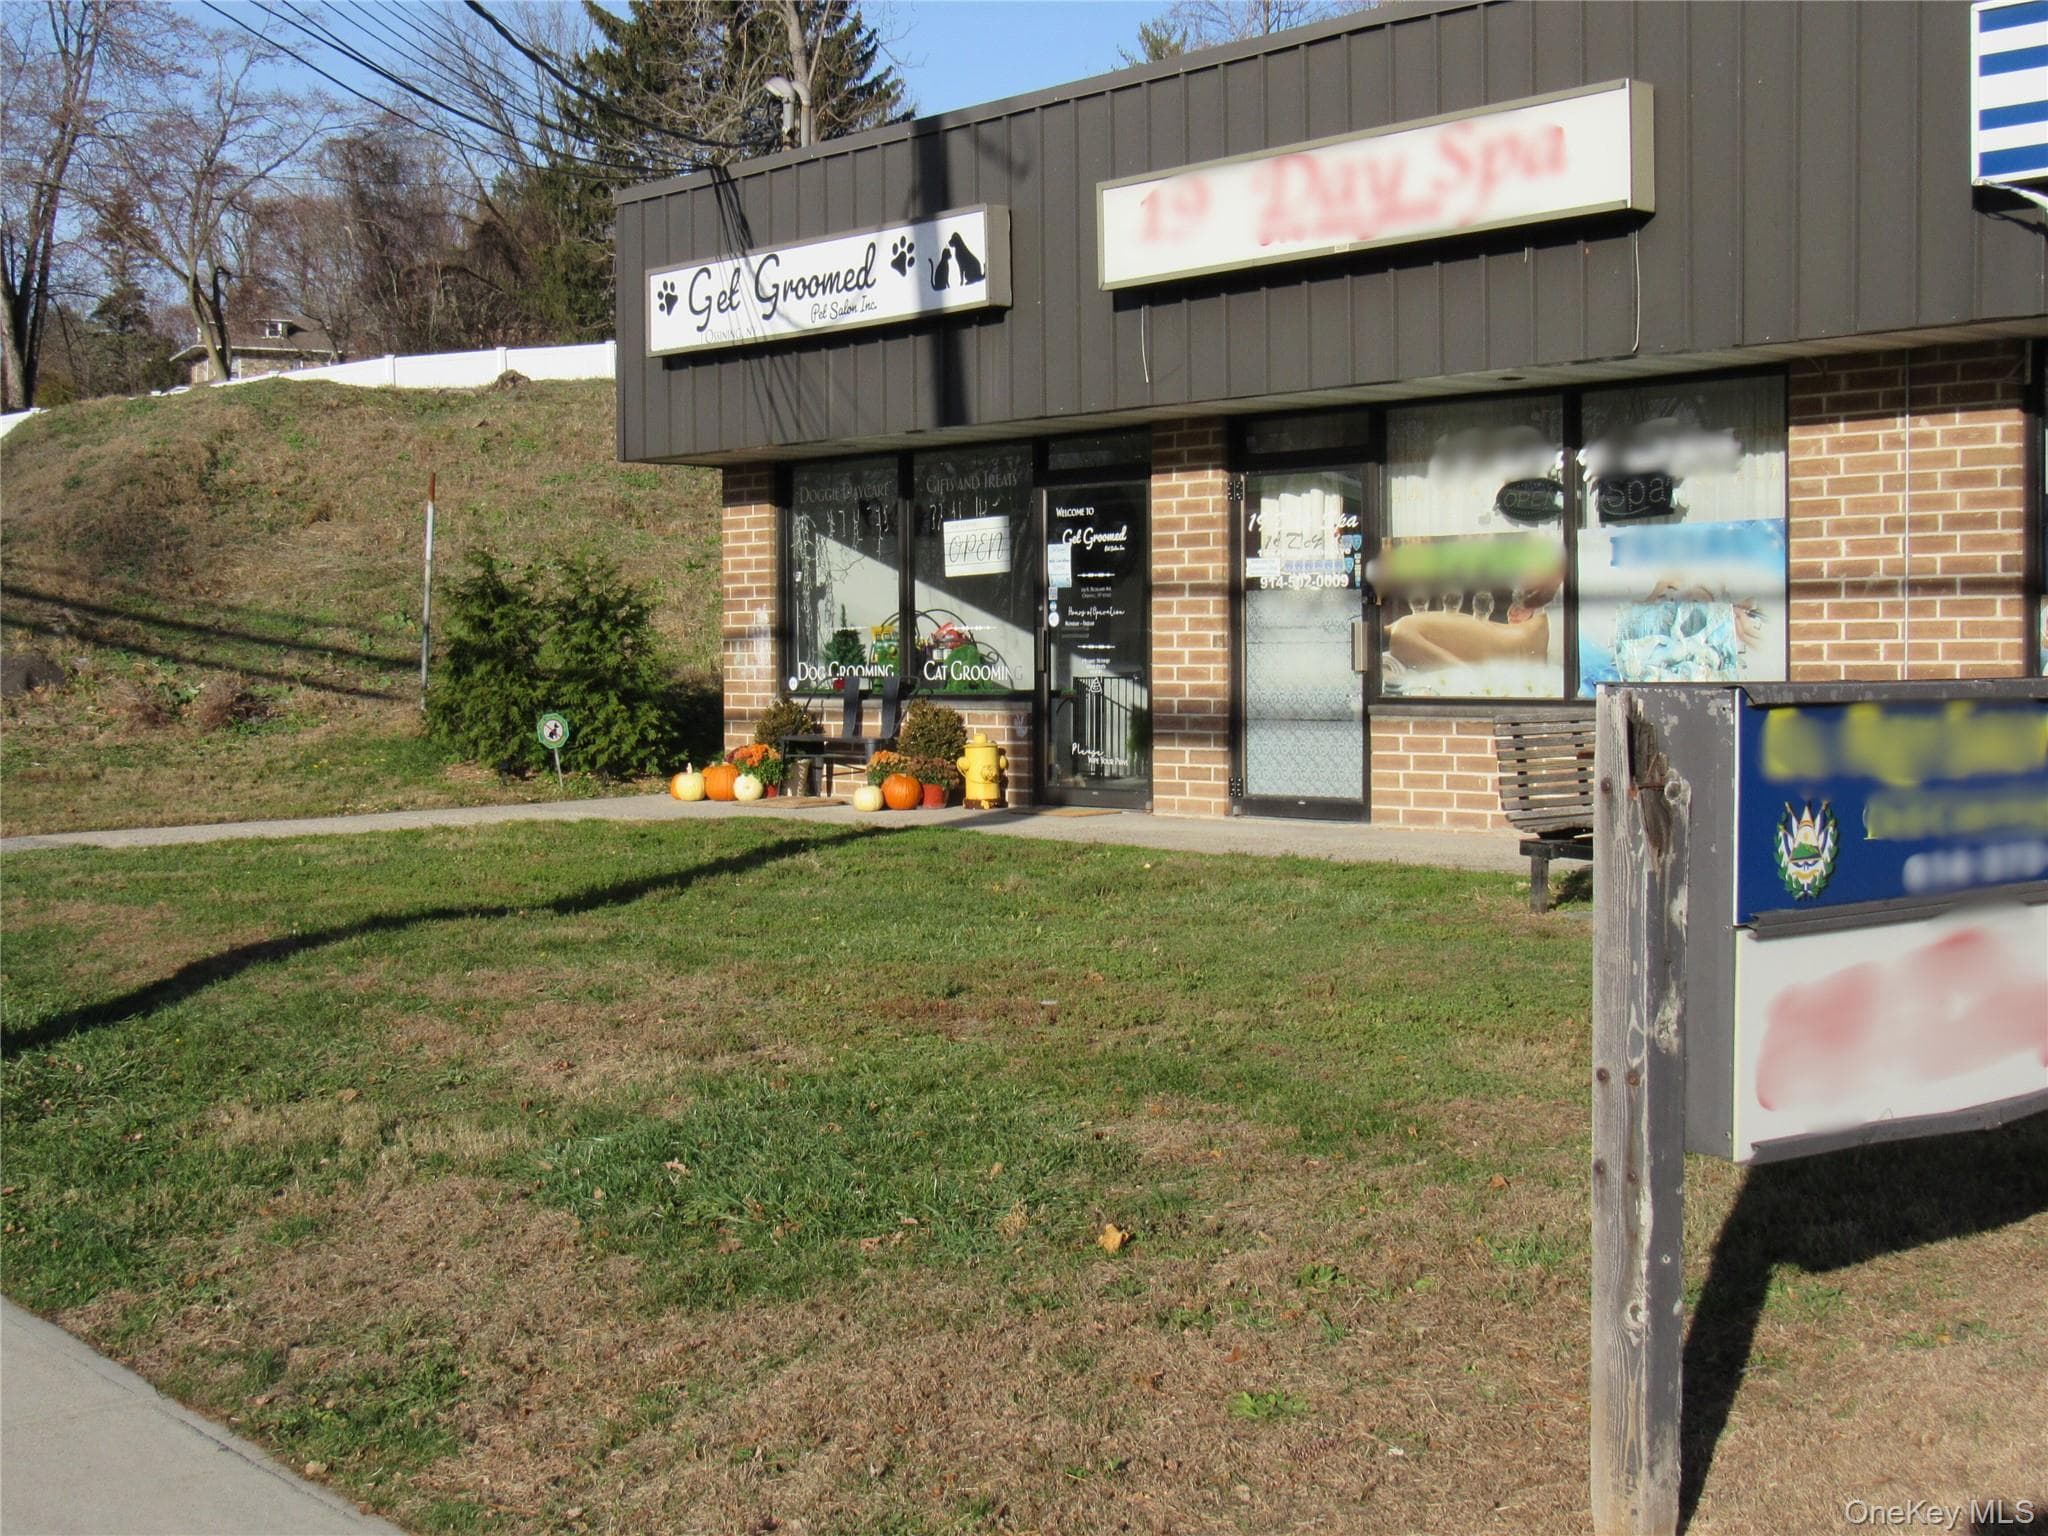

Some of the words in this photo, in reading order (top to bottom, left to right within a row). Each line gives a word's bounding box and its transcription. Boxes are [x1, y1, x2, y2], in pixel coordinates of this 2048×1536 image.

[688, 266, 742, 332] Get
[754, 241, 877, 320] Groomed
[810, 301, 828, 324] Pet
[829, 296, 859, 320] Salon
[859, 294, 878, 313] Inc.
[926, 477, 957, 494] GIFTS
[958, 475, 981, 490] AND
[983, 471, 1017, 488] TREATS
[1055, 506, 1085, 518] WELCOME
[1085, 506, 1095, 516] TO
[1062, 528, 1082, 546] Get
[1083, 524, 1128, 550] Groomed
[798, 661, 826, 681] DOG
[923, 660, 948, 681] CAT
[950, 660, 1024, 681] GROOMING
